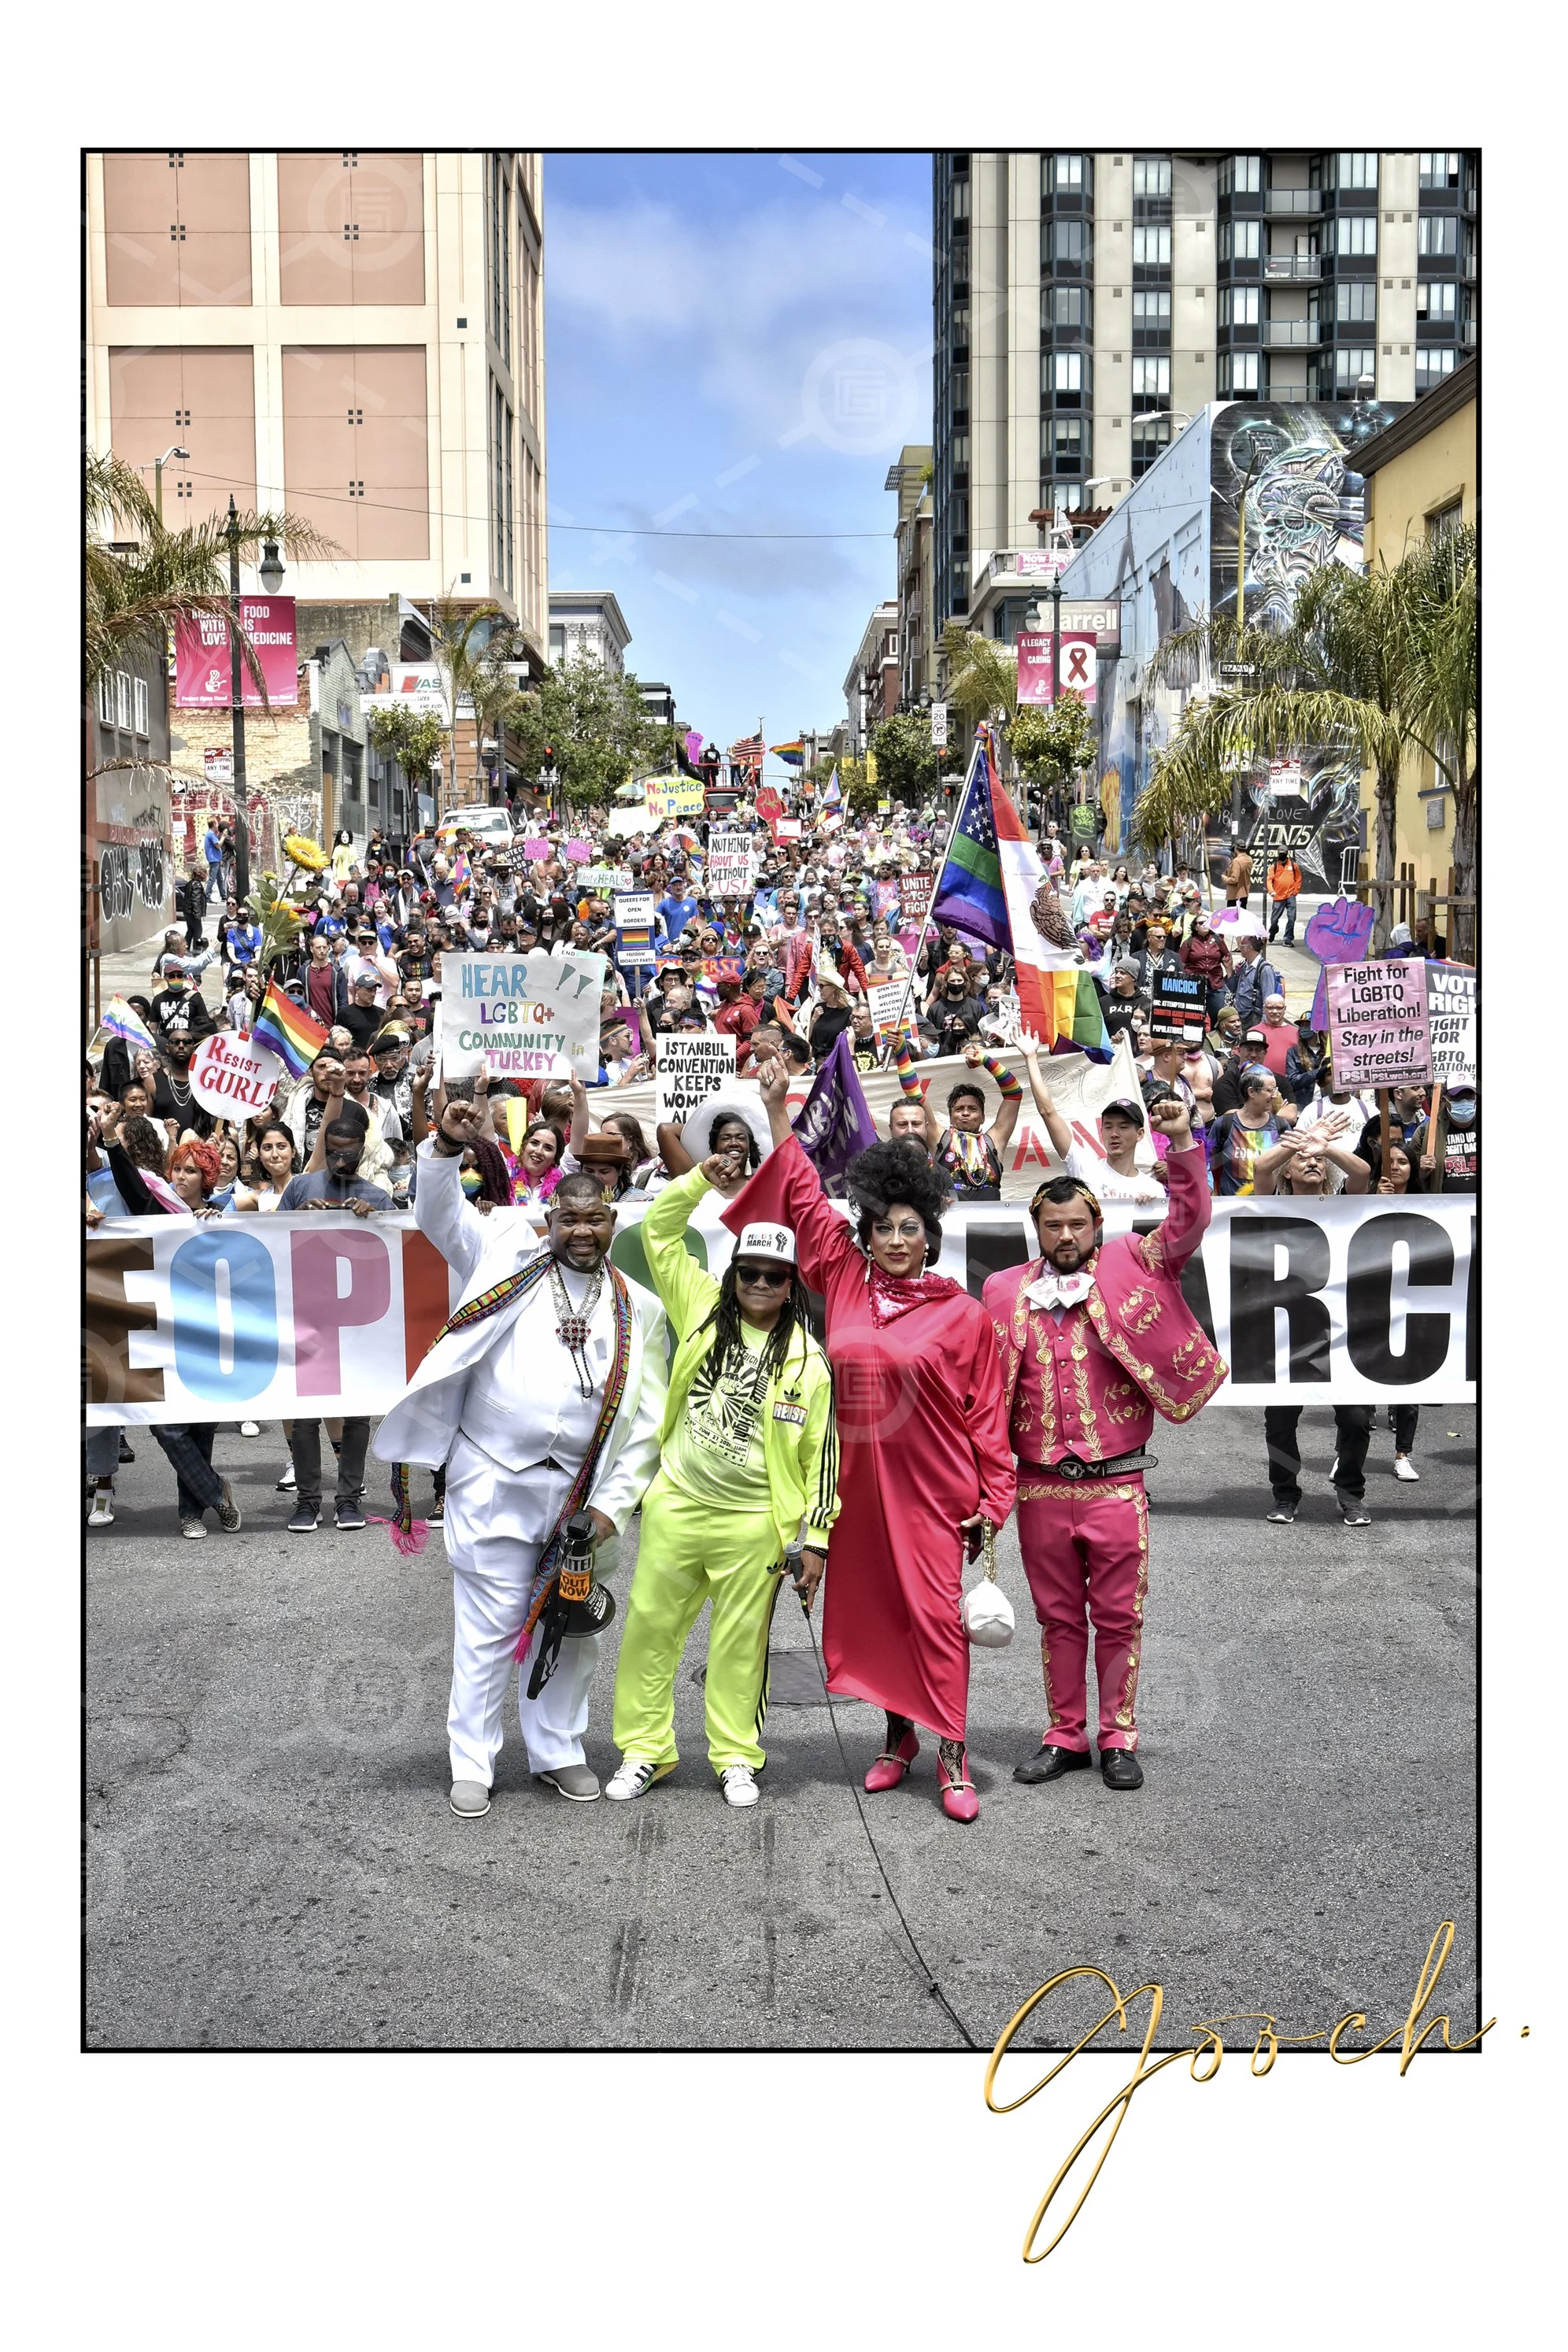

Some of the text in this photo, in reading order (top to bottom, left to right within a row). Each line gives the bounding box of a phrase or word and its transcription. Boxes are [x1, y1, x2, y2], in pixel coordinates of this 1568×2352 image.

[244, 606, 269, 619] FOOD
[245, 619, 253, 631] IS
[202, 633, 227, 645] LOVE
[1027, 638, 1052, 647] LEGACY
[1028, 656, 1052, 664] CARING
[646, 780, 702, 795] No Justice
[649, 800, 702, 816] No Peace
[1267, 808, 1307, 820] LOVE
[712, 838, 750, 853] NOTHING
[710, 855, 748, 869] ABOUT US
[597, 874, 625, 886] HEALS
[712, 867, 749, 882] WITHOUT
[718, 879, 747, 894] US!
[702, 959, 741, 973] IRST
[460, 963, 527, 998] HEAR
[1344, 964, 1410, 985] Fight for
[1162, 978, 1198, 995] HANCOCK
[1352, 984, 1404, 1004] LGBTQ
[879, 998, 902, 1008] WELCOME
[480, 1001, 554, 1025] LGBTQ+
[874, 1014, 897, 1023] DOMESTIC
[1337, 1001, 1422, 1023] Liberation!
[459, 1030, 584, 1056] COMMUNITY in
[1341, 1026, 1424, 1048] Stay in the
[1431, 1031, 1460, 1045] FOR
[485, 1050, 557, 1071] TURKEY
[1352, 1047, 1415, 1067] streets!
[657, 1058, 734, 1074] CONVENTION
[674, 1075, 721, 1091] KEEPS
[1341, 1070, 1370, 1084] PSL
[1371, 1071, 1428, 1082] PSLweb.org
[699, 1427, 711, 1437] JUNE
[562, 1575, 586, 1587] OUT
[560, 1583, 588, 1596] NOW
